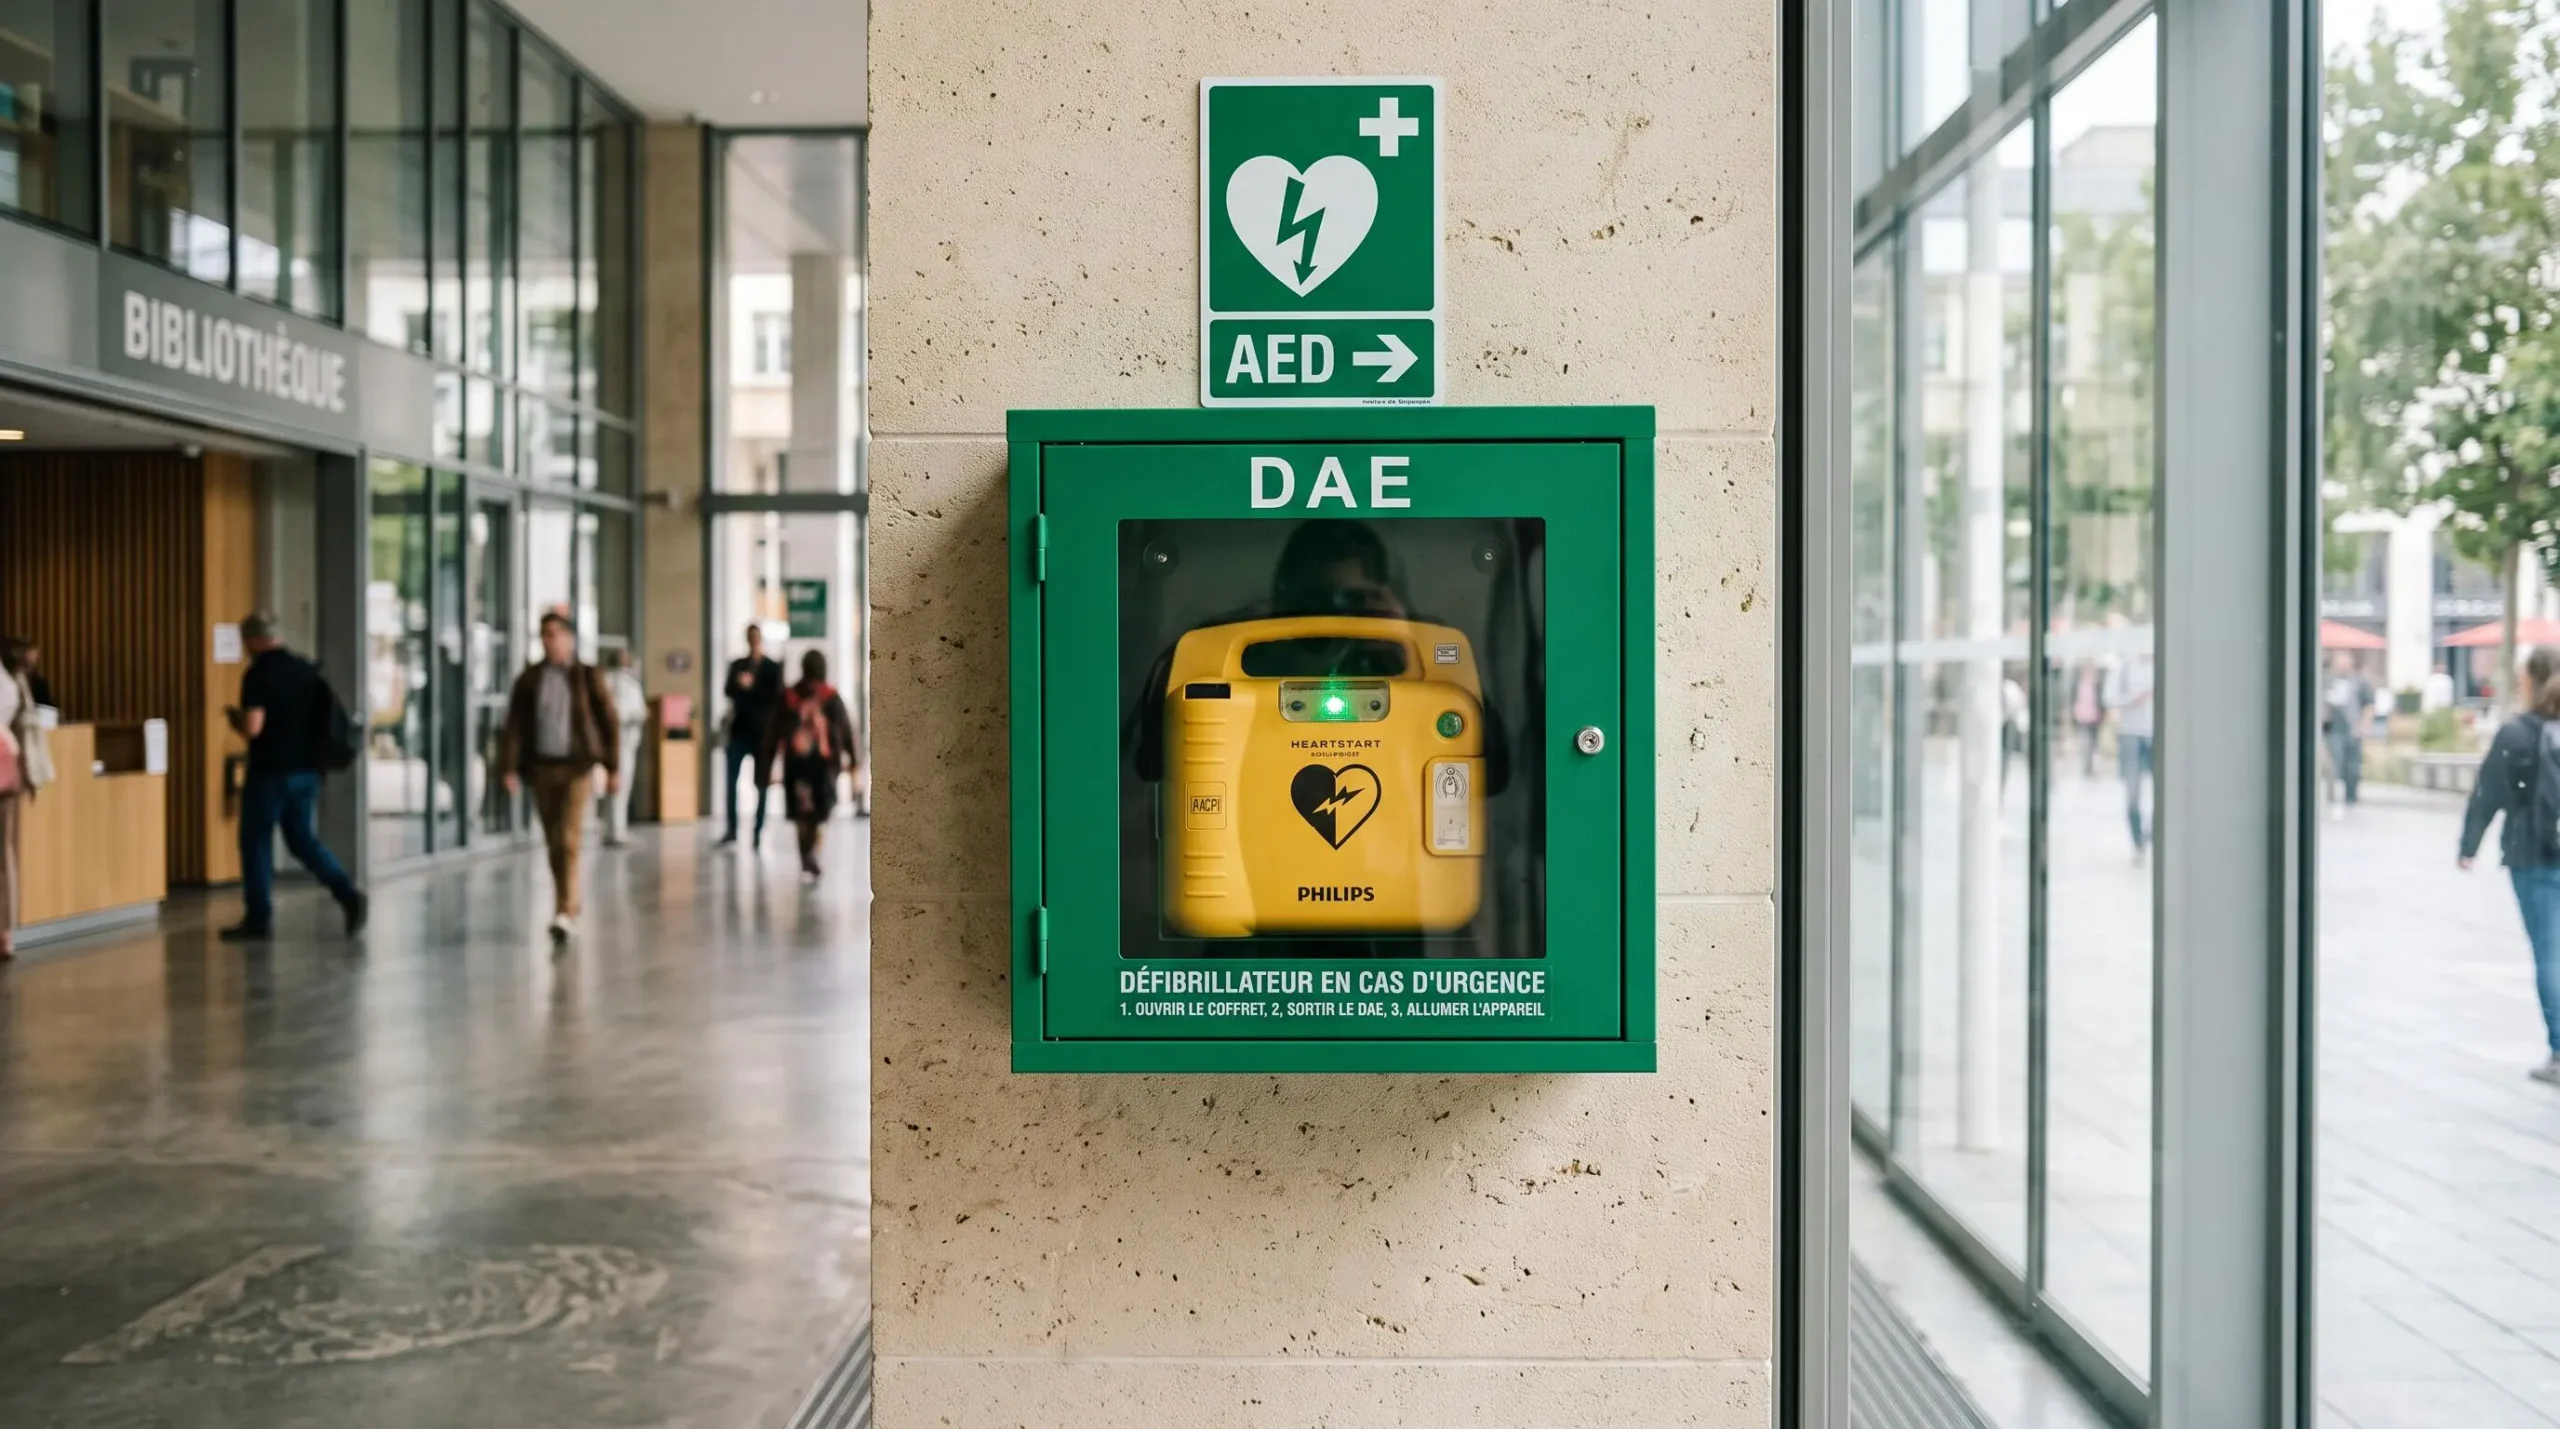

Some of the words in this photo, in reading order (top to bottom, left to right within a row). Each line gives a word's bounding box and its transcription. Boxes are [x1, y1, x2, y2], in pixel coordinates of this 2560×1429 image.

[124, 289, 347, 414] BIBLIOTHÈQUE
[1225, 334, 1335, 384] AED
[1250, 456, 1411, 508] DAE
[1291, 740, 1381, 748] HEARTSTART
[1298, 886, 1375, 901] PHILIPS
[1120, 965, 1314, 994] DÉFIBRILLATEUR
[1321, 971, 1351, 994] EN
[1359, 971, 1405, 994] CAS
[1413, 971, 1545, 994] D'URGENCE
[1120, 1003, 1132, 1016] 1.
[1135, 1002, 1185, 1016] OUVRIR
[1189, 1002, 1205, 1016] LE
[1207, 1002, 1268, 1018] COFFRET,
[1271, 1002, 1283, 1018] 2,
[1287, 1002, 1335, 1016] SORTIR
[1339, 1002, 1354, 1016] LE
[1358, 1002, 1387, 1018] DAE,
[1391, 1002, 1403, 1018] 3,
[1407, 1002, 1469, 1016] ALLUMER
[1473, 1002, 1545, 1016] L'APPAREIL
